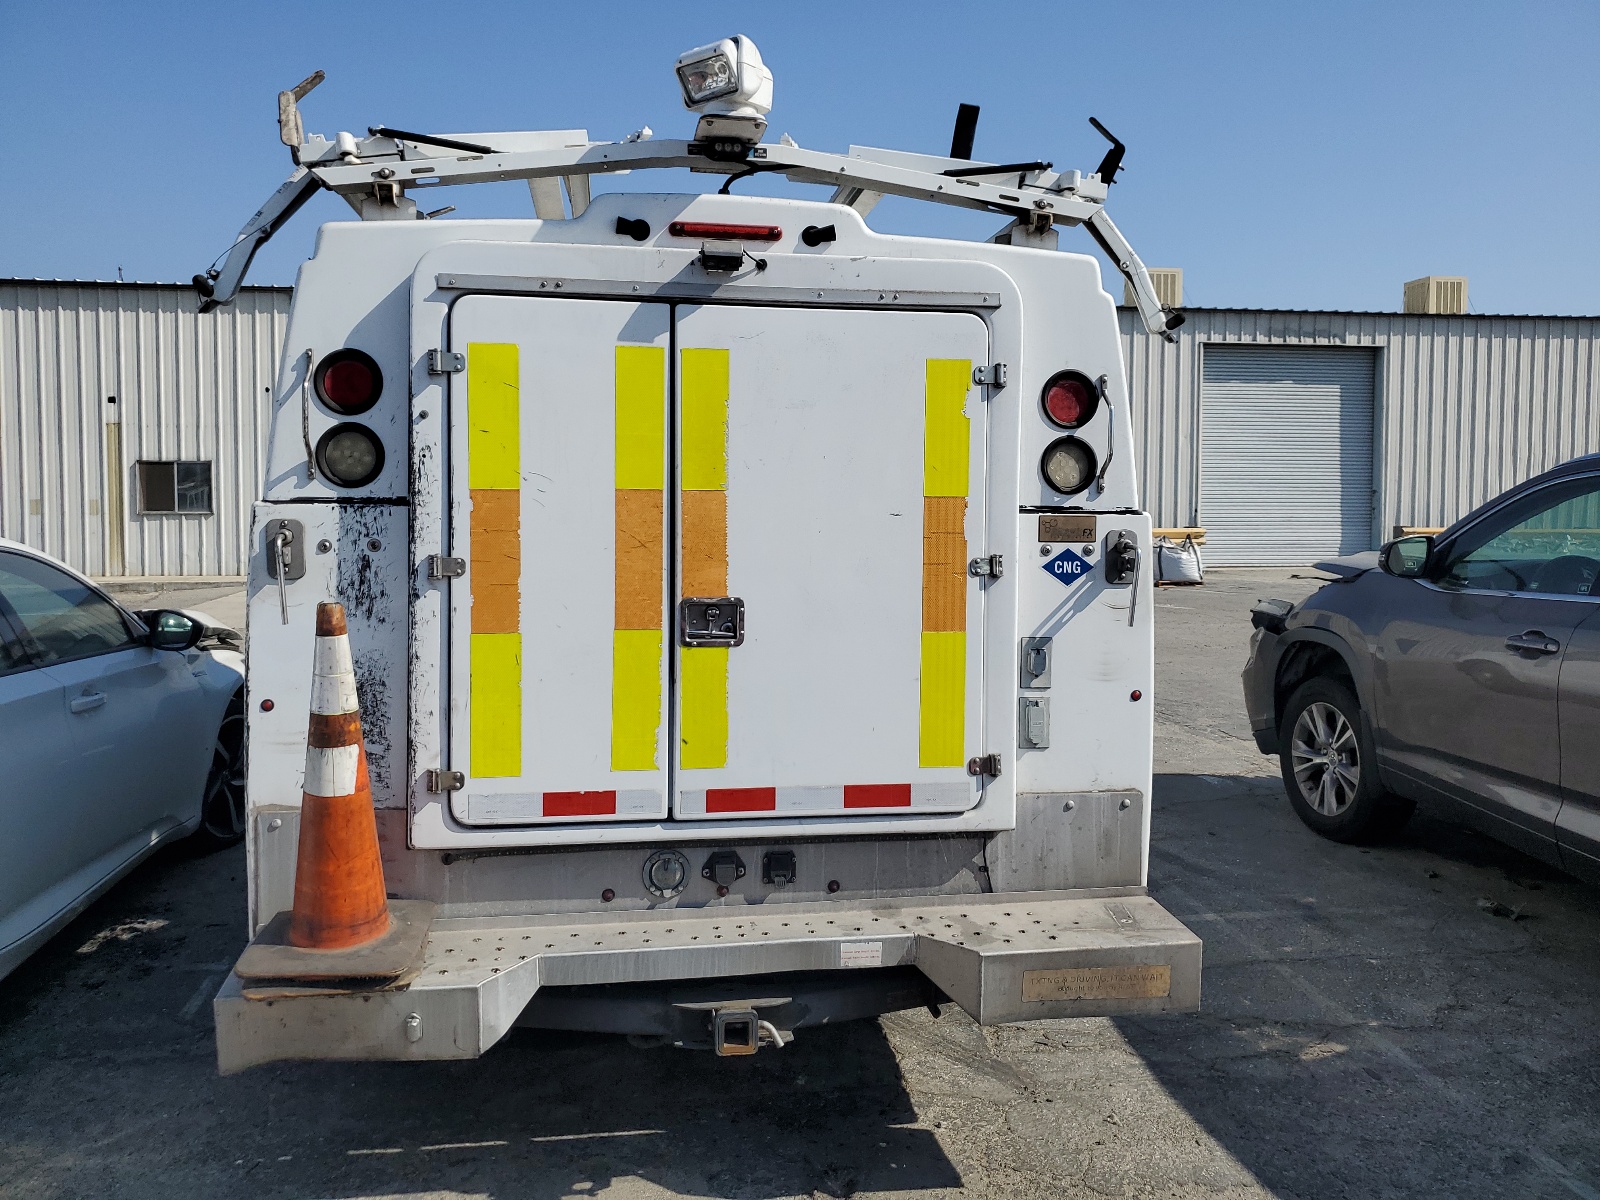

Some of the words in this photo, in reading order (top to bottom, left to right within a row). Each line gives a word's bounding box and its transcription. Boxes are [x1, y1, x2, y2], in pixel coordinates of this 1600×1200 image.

[1082, 528, 1094, 537] FX
[1054, 561, 1081, 574] CNG
[1142, 973, 1164, 982] WAIT
